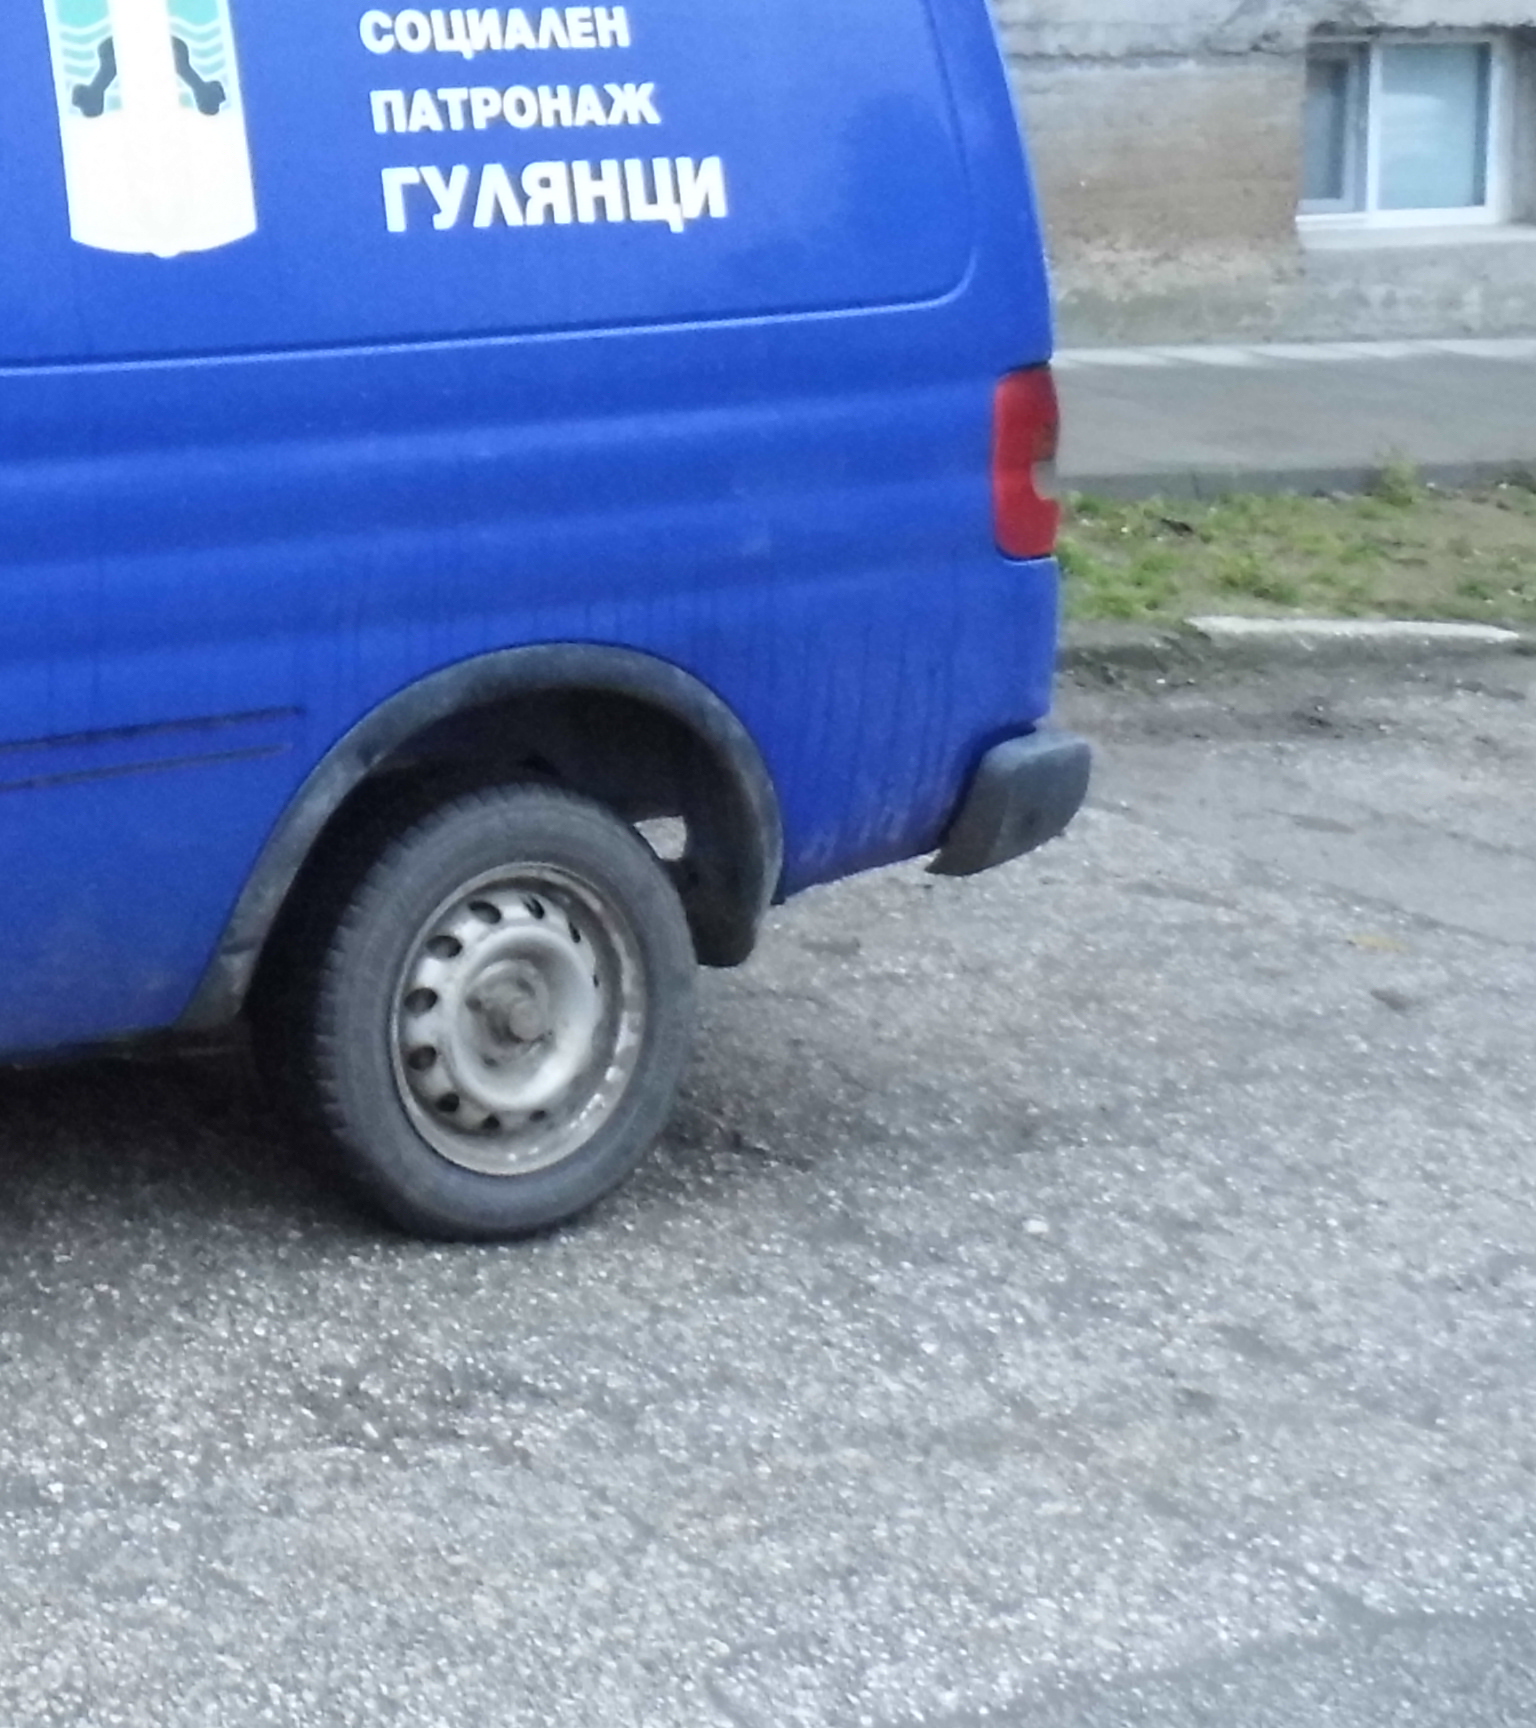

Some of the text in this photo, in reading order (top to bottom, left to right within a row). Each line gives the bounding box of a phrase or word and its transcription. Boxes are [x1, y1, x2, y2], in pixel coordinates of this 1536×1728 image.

[359, 6, 630, 60] СОЦИАЛЕН
[370, 82, 662, 133] ПАТРОНАЖ
[381, 156, 728, 233] ГУЛЯНЦИ
